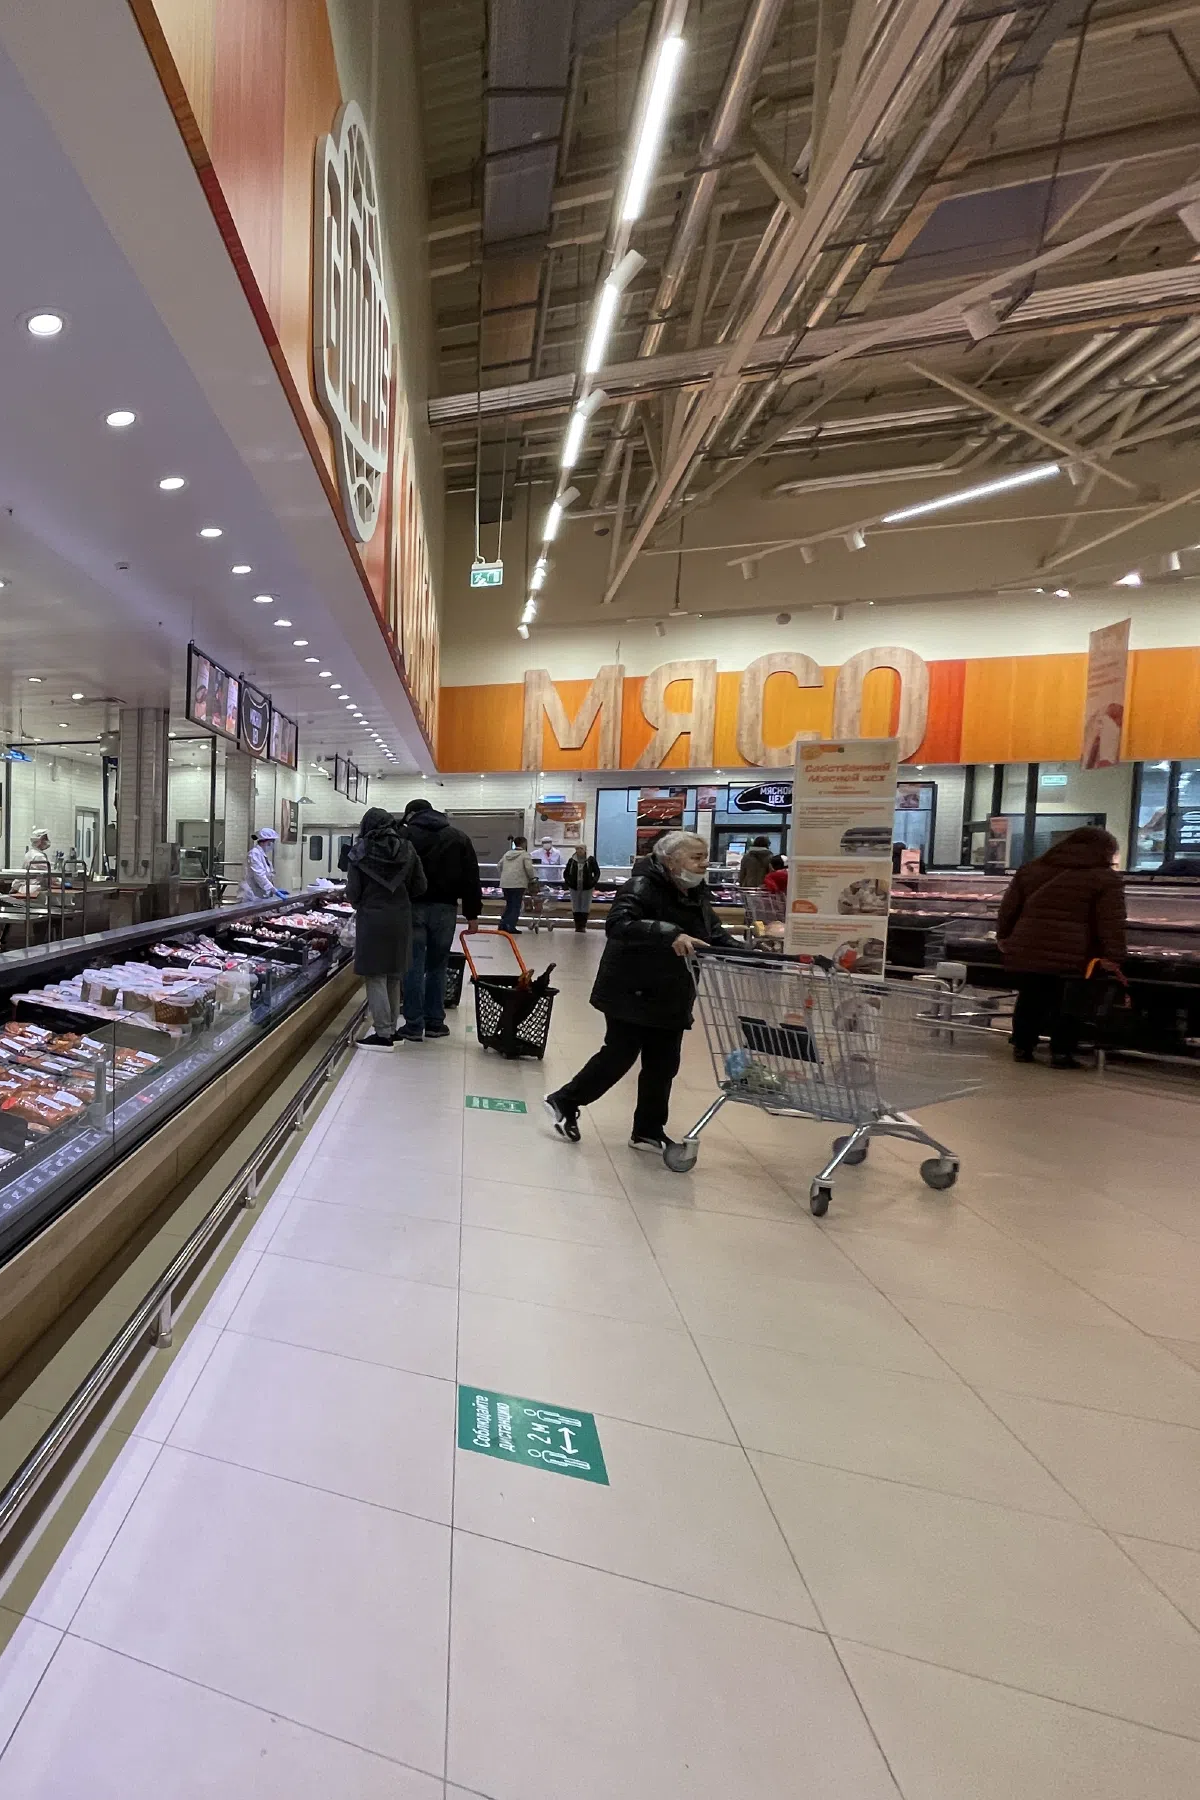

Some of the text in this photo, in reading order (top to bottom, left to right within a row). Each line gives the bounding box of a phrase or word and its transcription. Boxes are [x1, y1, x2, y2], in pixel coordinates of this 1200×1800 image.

[522, 647, 929, 770] МЯСО
[768, 795, 785, 804] ЦЕХ
[472, 1395, 491, 1448] Соблюдайте
